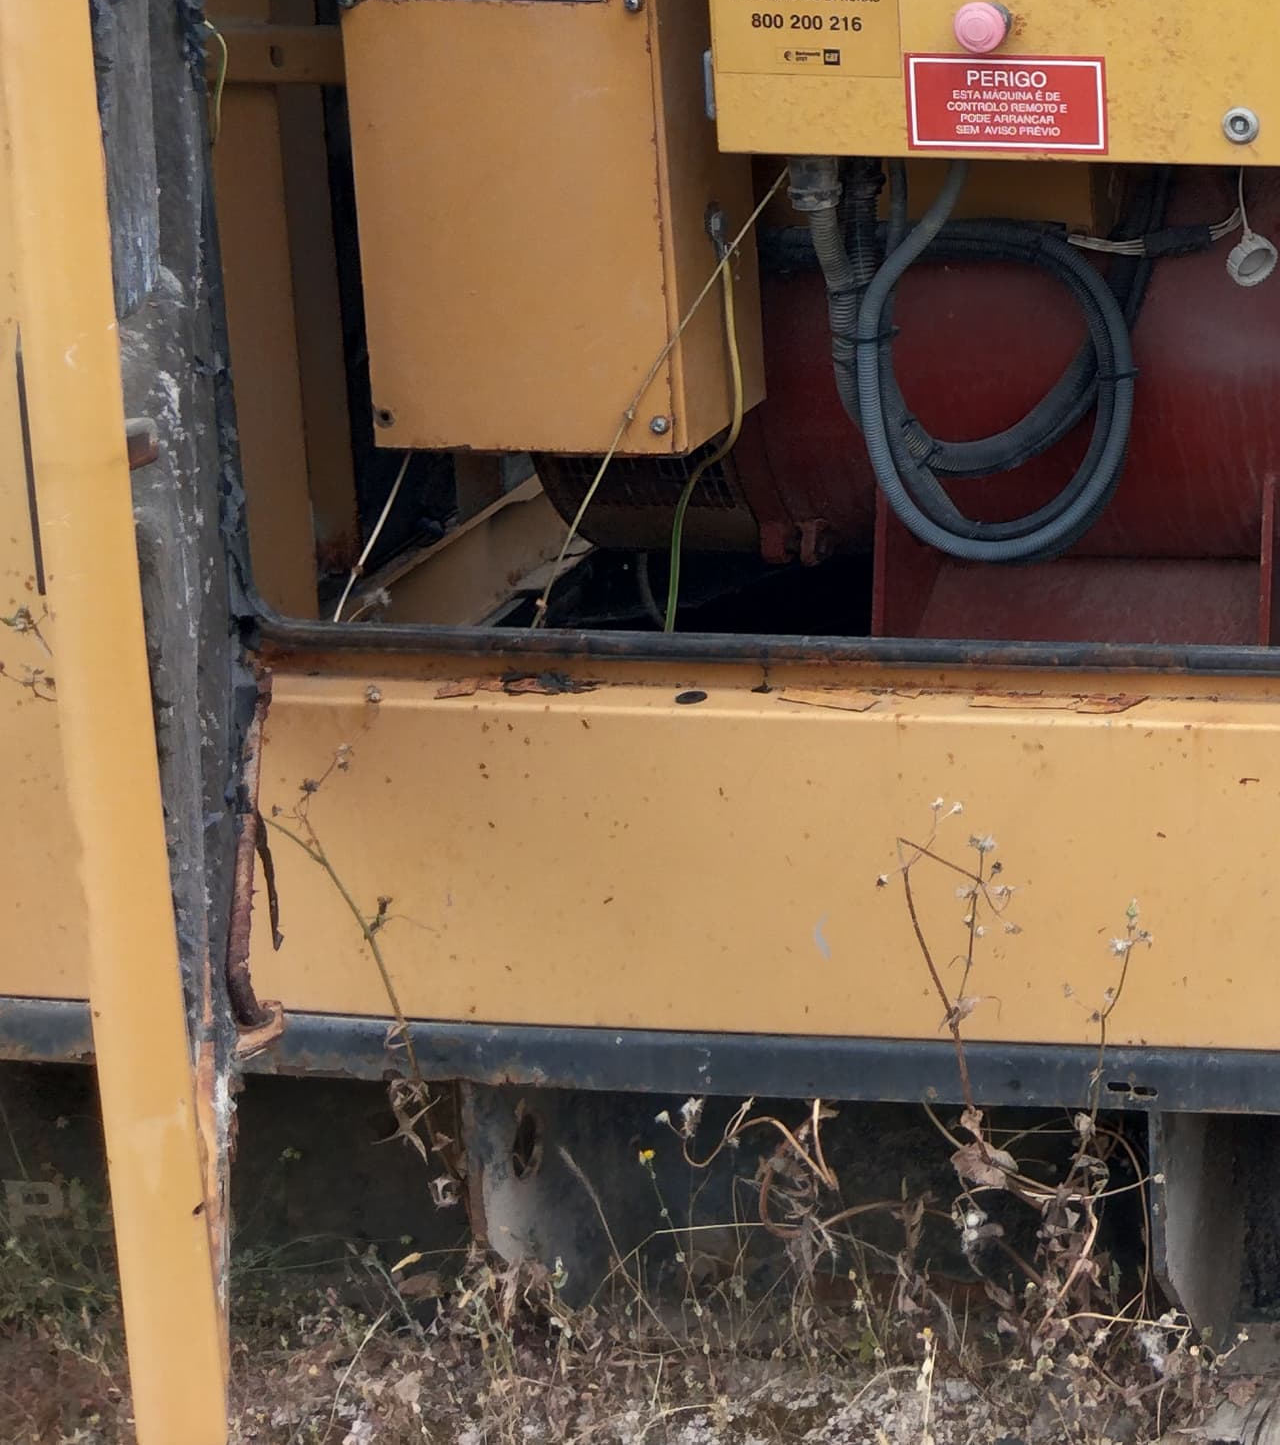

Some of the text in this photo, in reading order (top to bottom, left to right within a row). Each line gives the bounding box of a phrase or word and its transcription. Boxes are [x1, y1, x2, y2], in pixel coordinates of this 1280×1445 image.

[751, 13, 862, 32] 800 200 216
[966, 70, 1047, 88] PERIGO
[952, 89, 981, 100] ESTA
[983, 89, 1033, 101] MÁQUINA
[1045, 92, 1061, 102] DE
[946, 101, 1068, 114] CONTROLO REMOTO E
[960, 113, 1055, 125] PODE ARRANCAR
[955, 124, 1061, 137] SEM AVISO PRÉVIO
